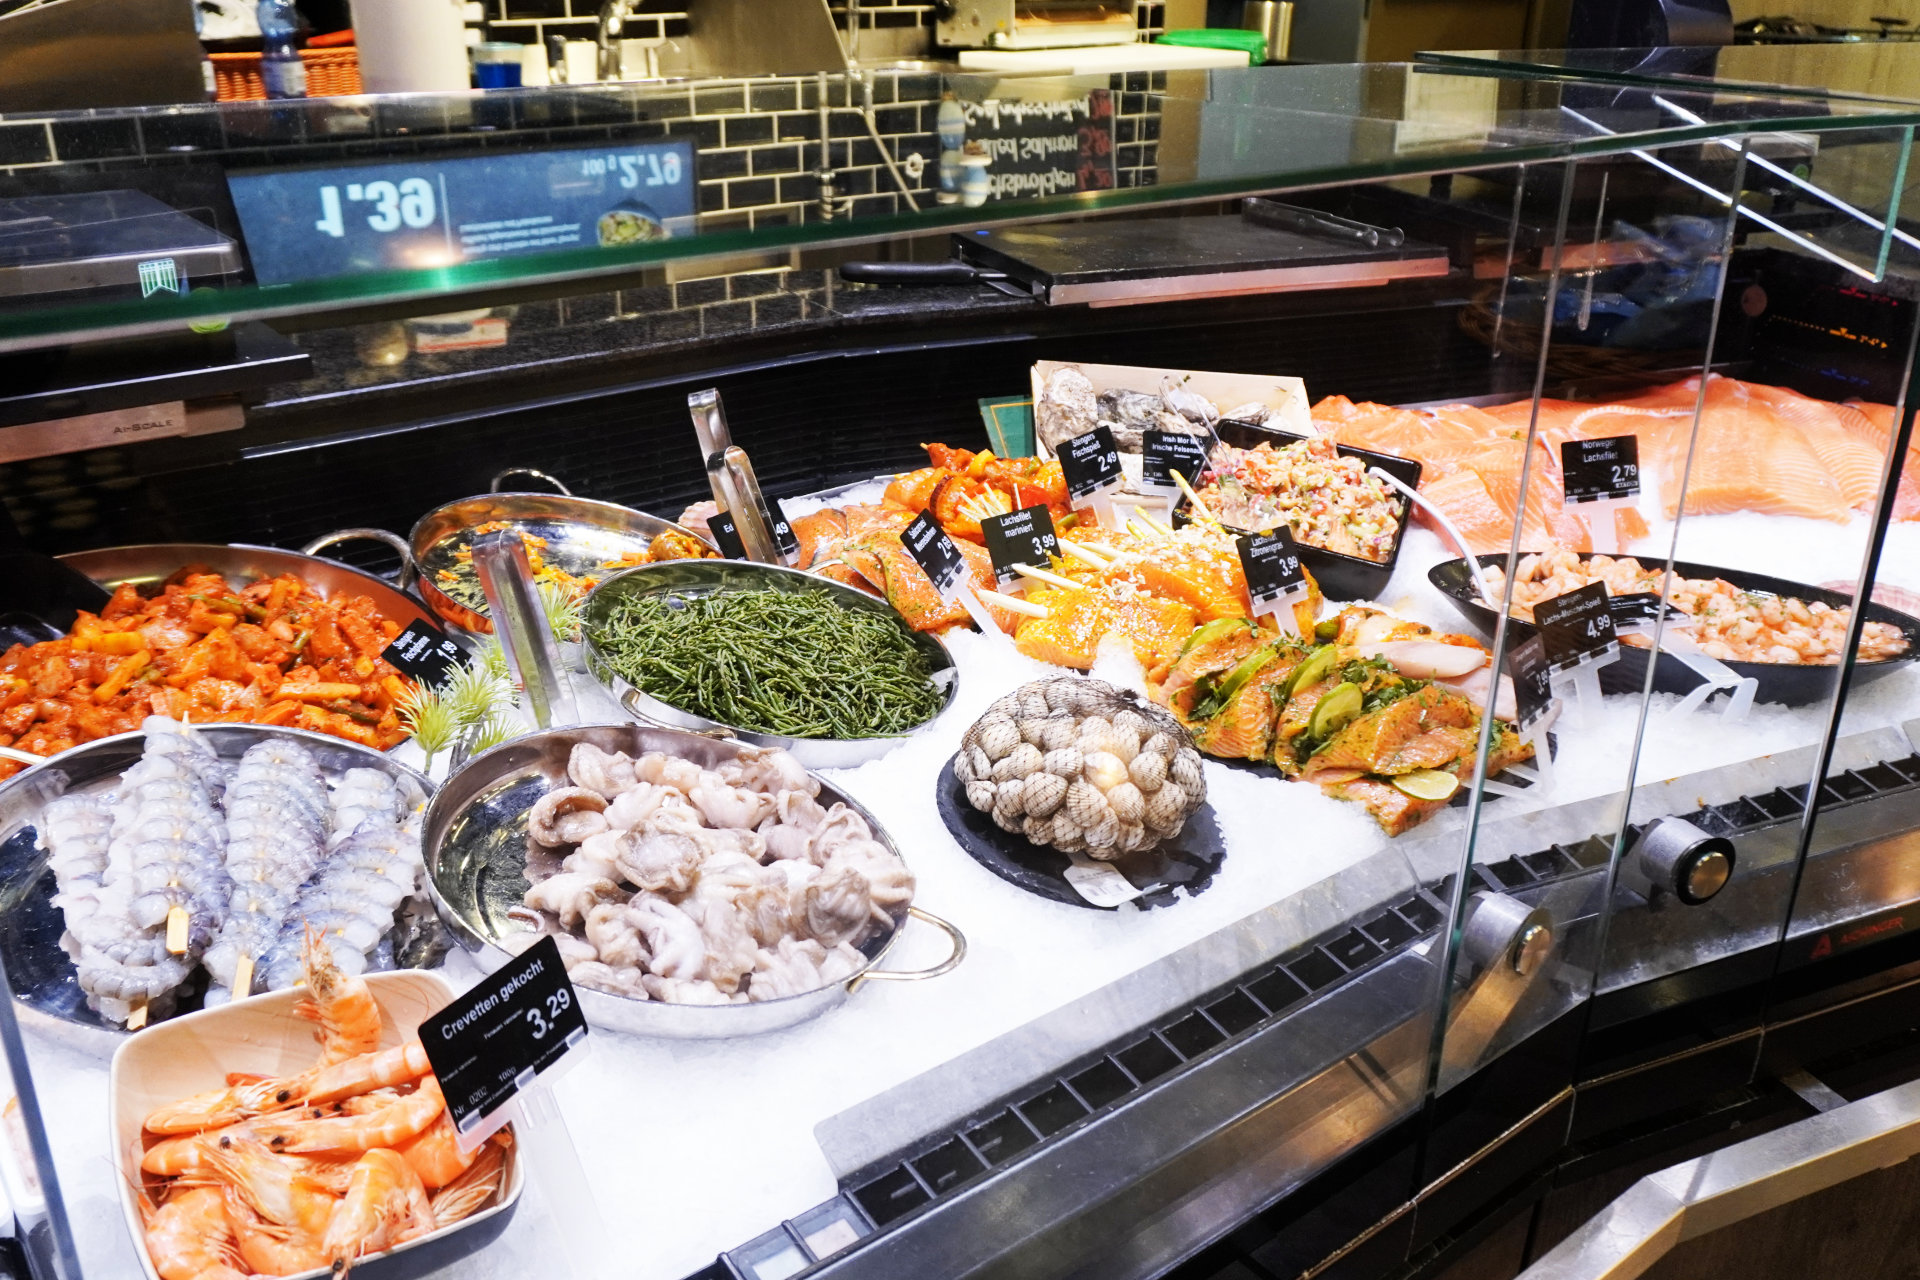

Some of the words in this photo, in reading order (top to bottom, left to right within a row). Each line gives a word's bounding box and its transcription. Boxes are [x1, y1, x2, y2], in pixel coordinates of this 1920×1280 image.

[1097, 451, 1118, 472] 2.49
[1583, 451, 1619, 463] Lachsfilet
[1611, 464, 1637, 483] 2.79
[999, 510, 1032, 527] Lachsfilet
[1004, 522, 1034, 539] mariniert
[1031, 533, 1056, 556] 3.99
[1278, 555, 1299, 577] 3.99
[1587, 613, 1611, 638] 4.99
[441, 994, 500, 1040] Crevetten
[499, 958, 545, 1002] gekocht
[526, 987, 571, 1040] 3.29
